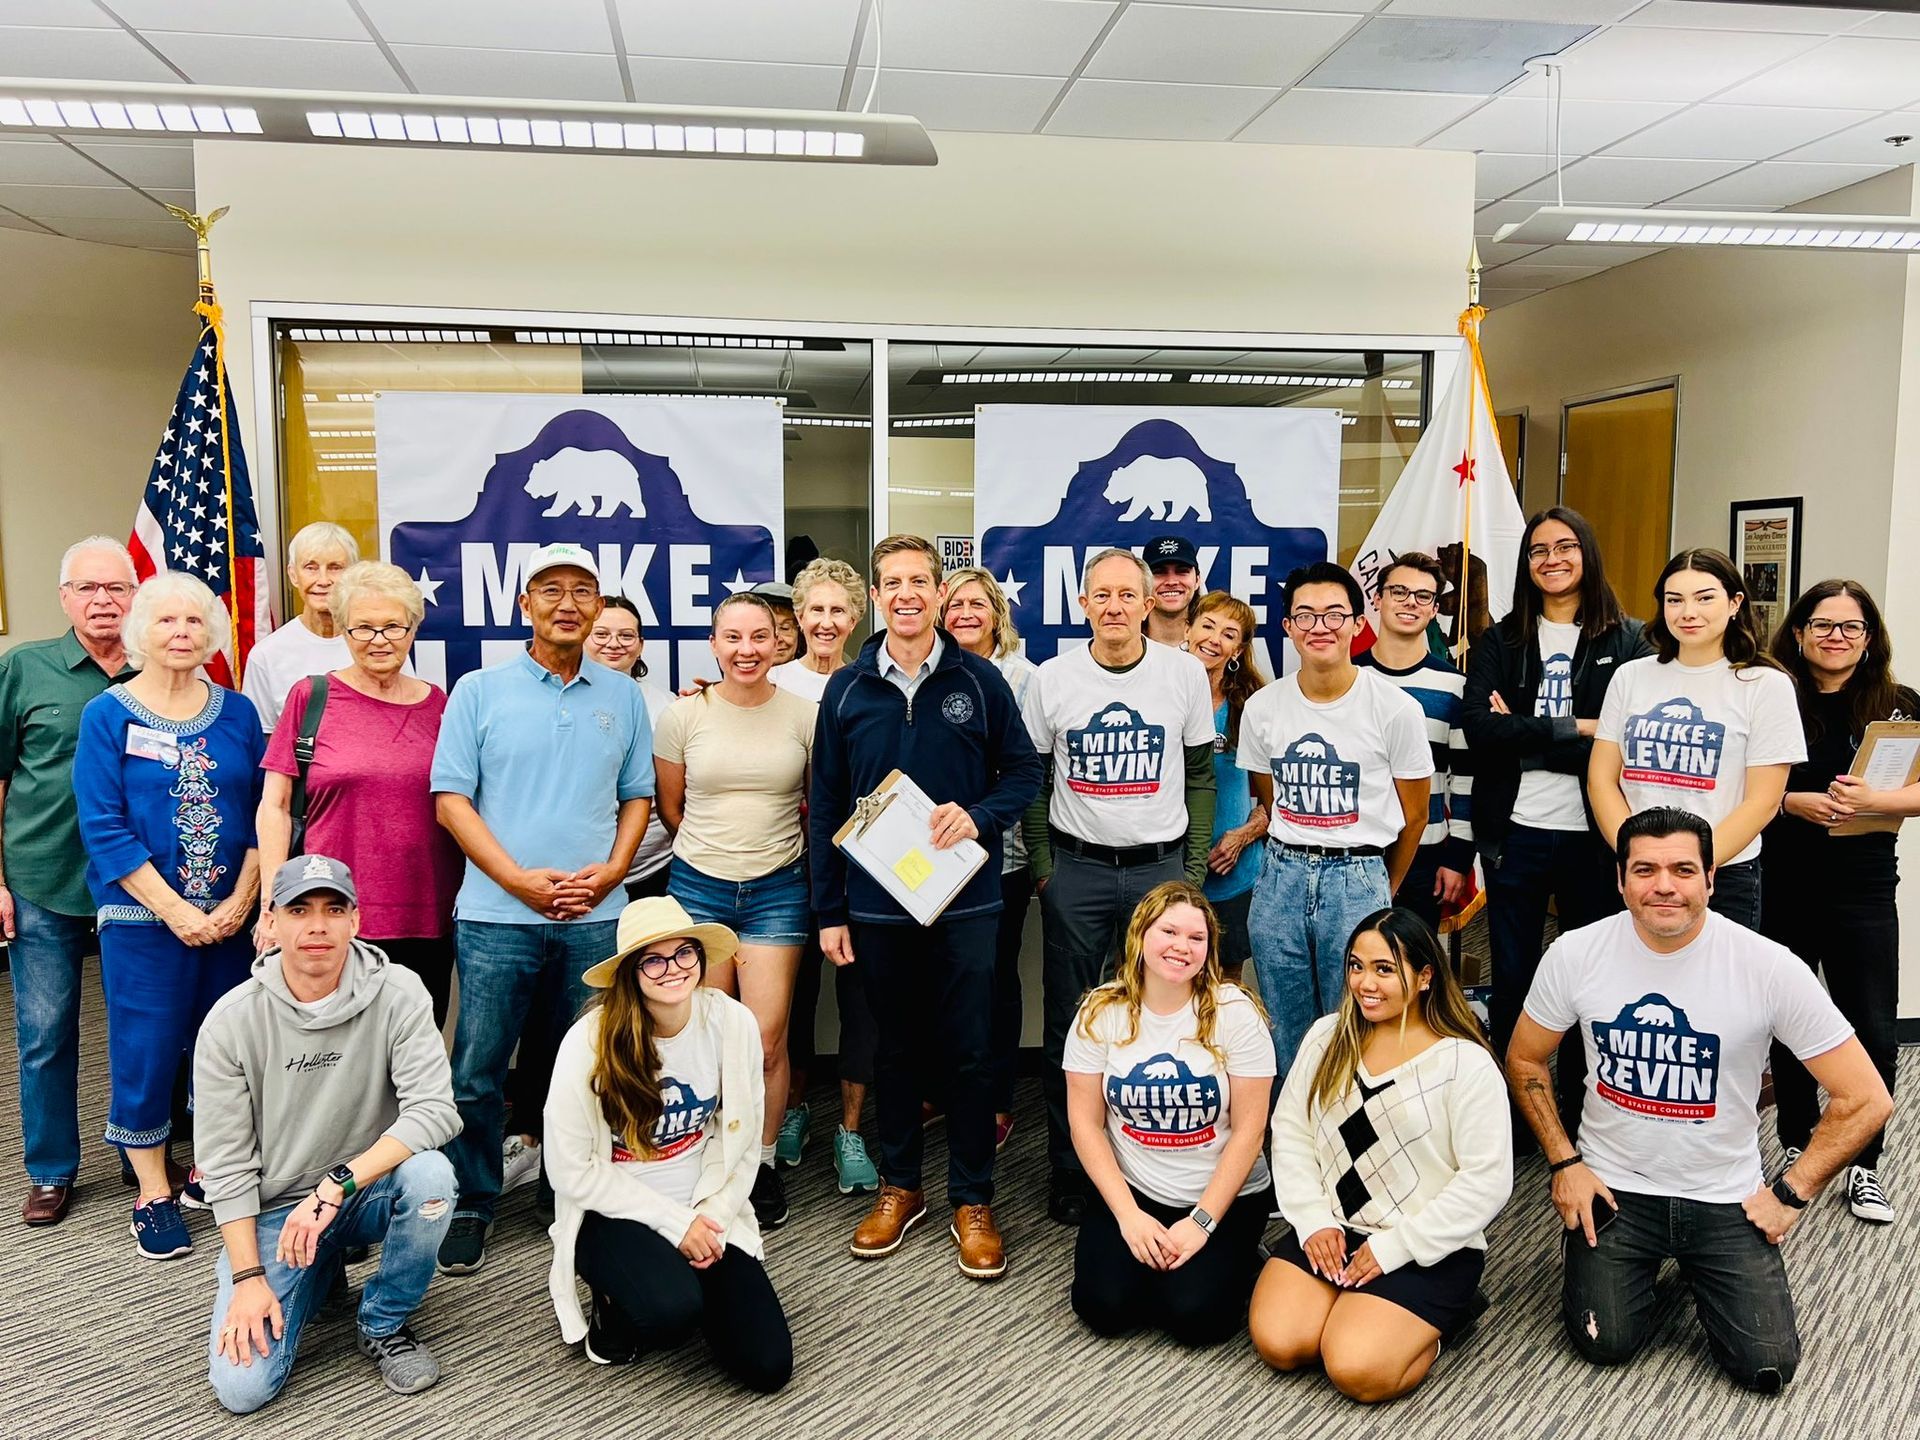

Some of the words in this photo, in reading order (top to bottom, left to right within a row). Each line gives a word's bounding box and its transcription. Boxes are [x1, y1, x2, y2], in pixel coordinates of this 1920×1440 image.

[460, 542, 713, 627] MKE
[1082, 729, 1149, 754] MIKE
[1633, 718, 1706, 745] MIKE
[1070, 752, 1161, 782] LEVIN
[1624, 739, 1717, 776] LEVIN
[1281, 762, 1343, 785] MIKE
[1647, 774, 1671, 782] STATES
[1673, 777, 1707, 787] CONGRESS
[1119, 785, 1152, 793] CONGRESS
[1277, 782, 1355, 814] LEVIN
[1608, 1028, 1698, 1064] MIKE
[285, 1052, 343, 1072] Hollister
[1600, 1051, 1713, 1101] LEVIN
[1120, 1082, 1204, 1107] MIKE
[1602, 1090, 1626, 1104] UNITED
[1628, 1100, 1657, 1112] STATES
[1659, 1106, 1705, 1116] CONGRESS
[654, 1106, 704, 1136] IKE
[1110, 1104, 1218, 1131] LEVIN
[1147, 1136, 1172, 1144] STATES
[1174, 1132, 1210, 1145] CONGRESS
